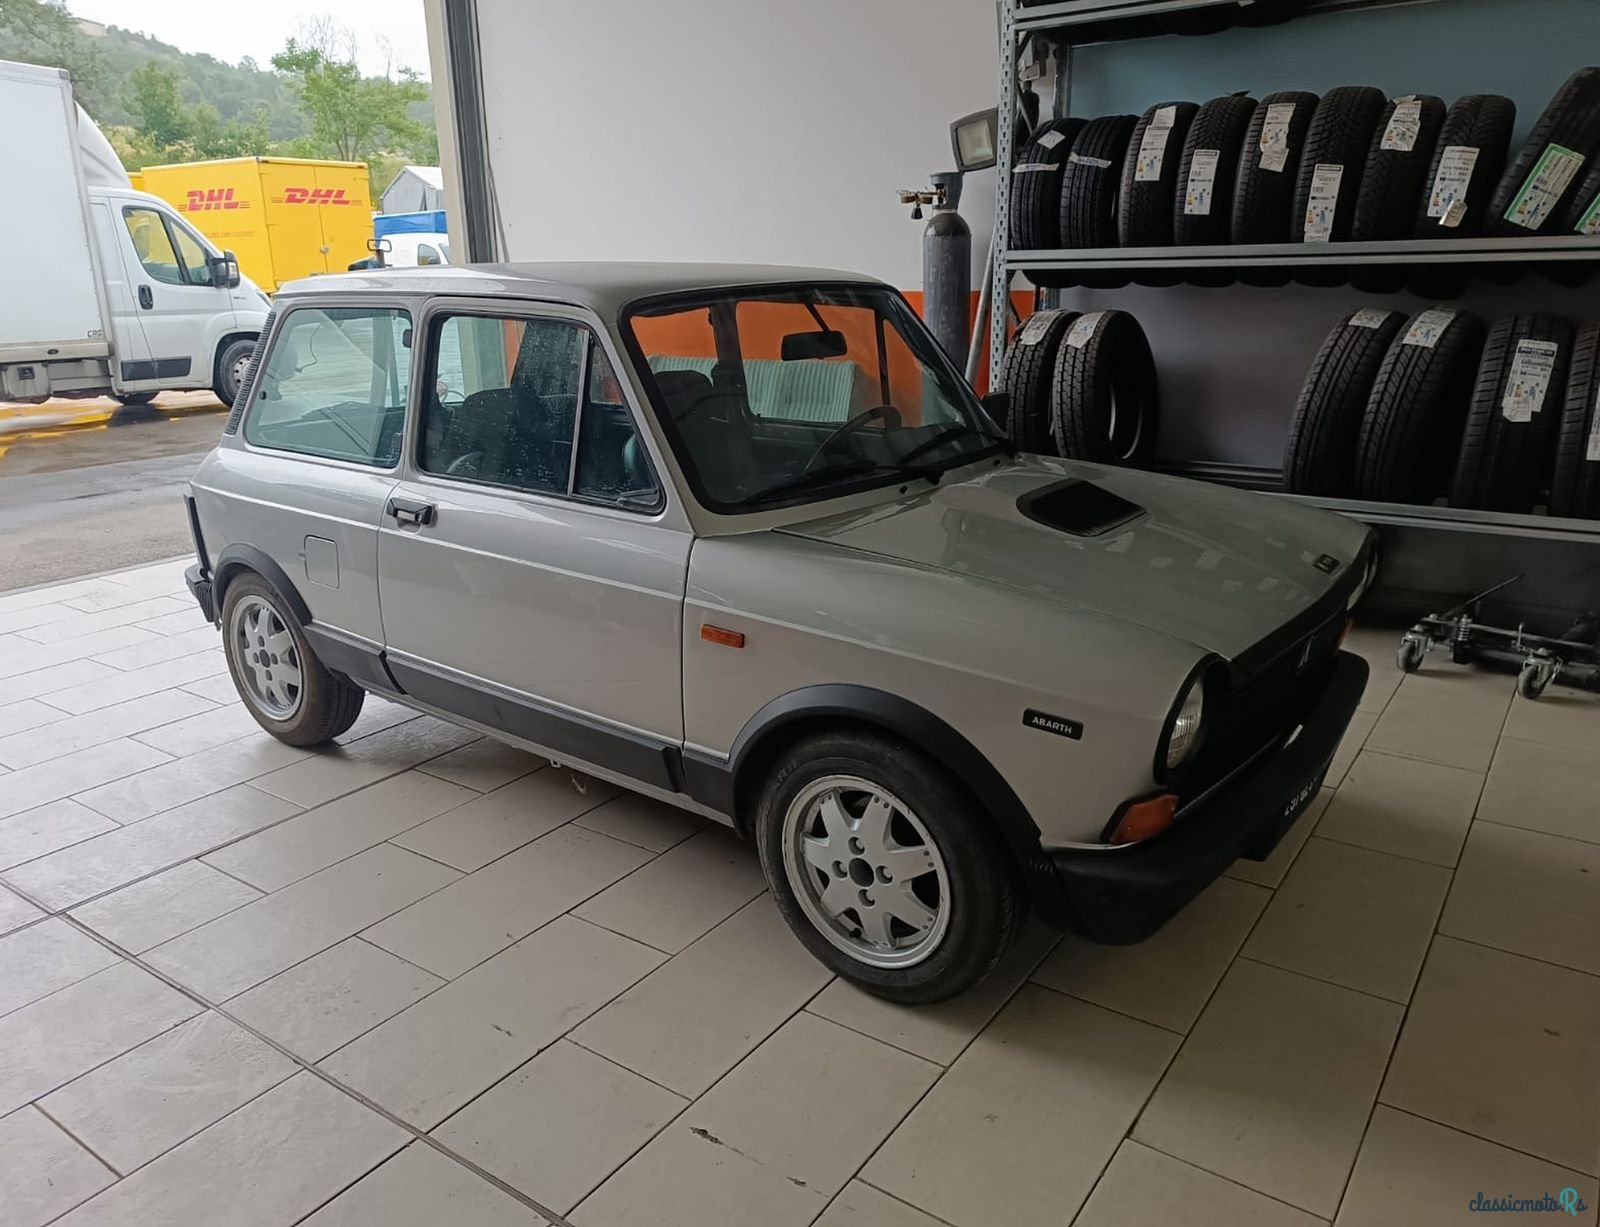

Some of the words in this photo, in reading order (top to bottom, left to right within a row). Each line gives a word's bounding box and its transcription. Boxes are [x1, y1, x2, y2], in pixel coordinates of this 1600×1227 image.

[187, 188, 239, 211] DHL
[284, 187, 350, 205] DHL
[1031, 716, 1073, 734] ABARTH
